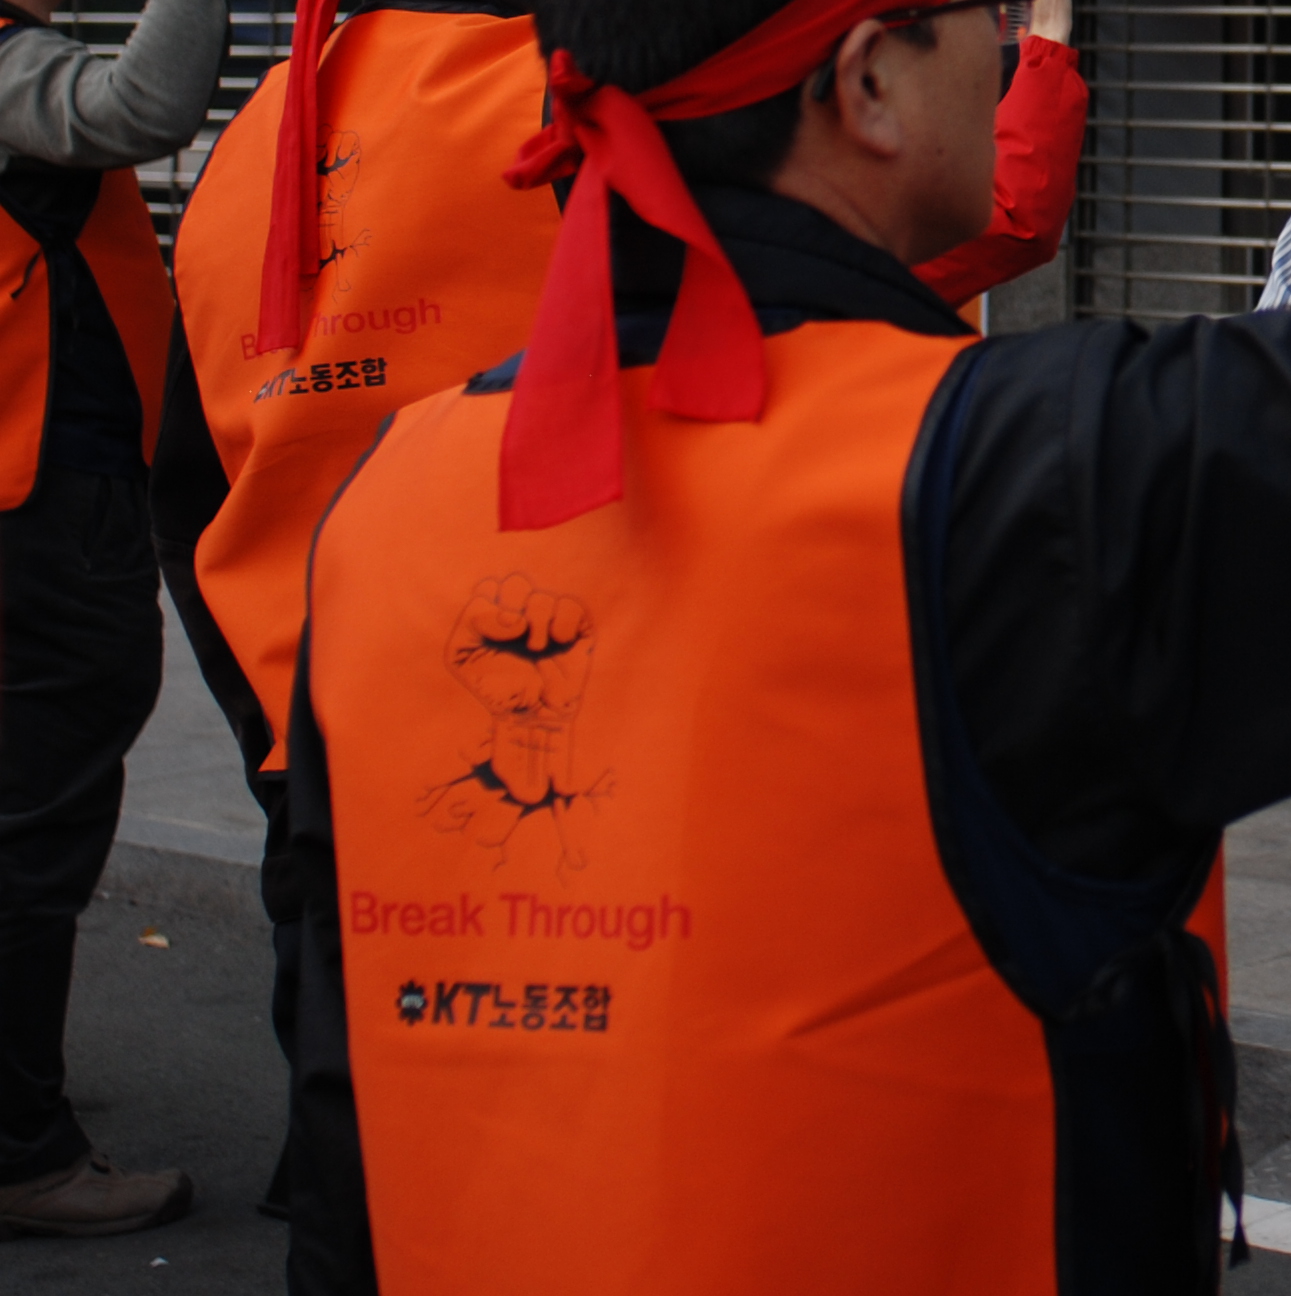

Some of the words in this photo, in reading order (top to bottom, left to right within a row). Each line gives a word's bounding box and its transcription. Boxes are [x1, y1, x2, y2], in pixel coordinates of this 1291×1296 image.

[349, 891, 485, 938] Break
[498, 892, 694, 952] Through
[431, 981, 612, 1032] KT노동조합
